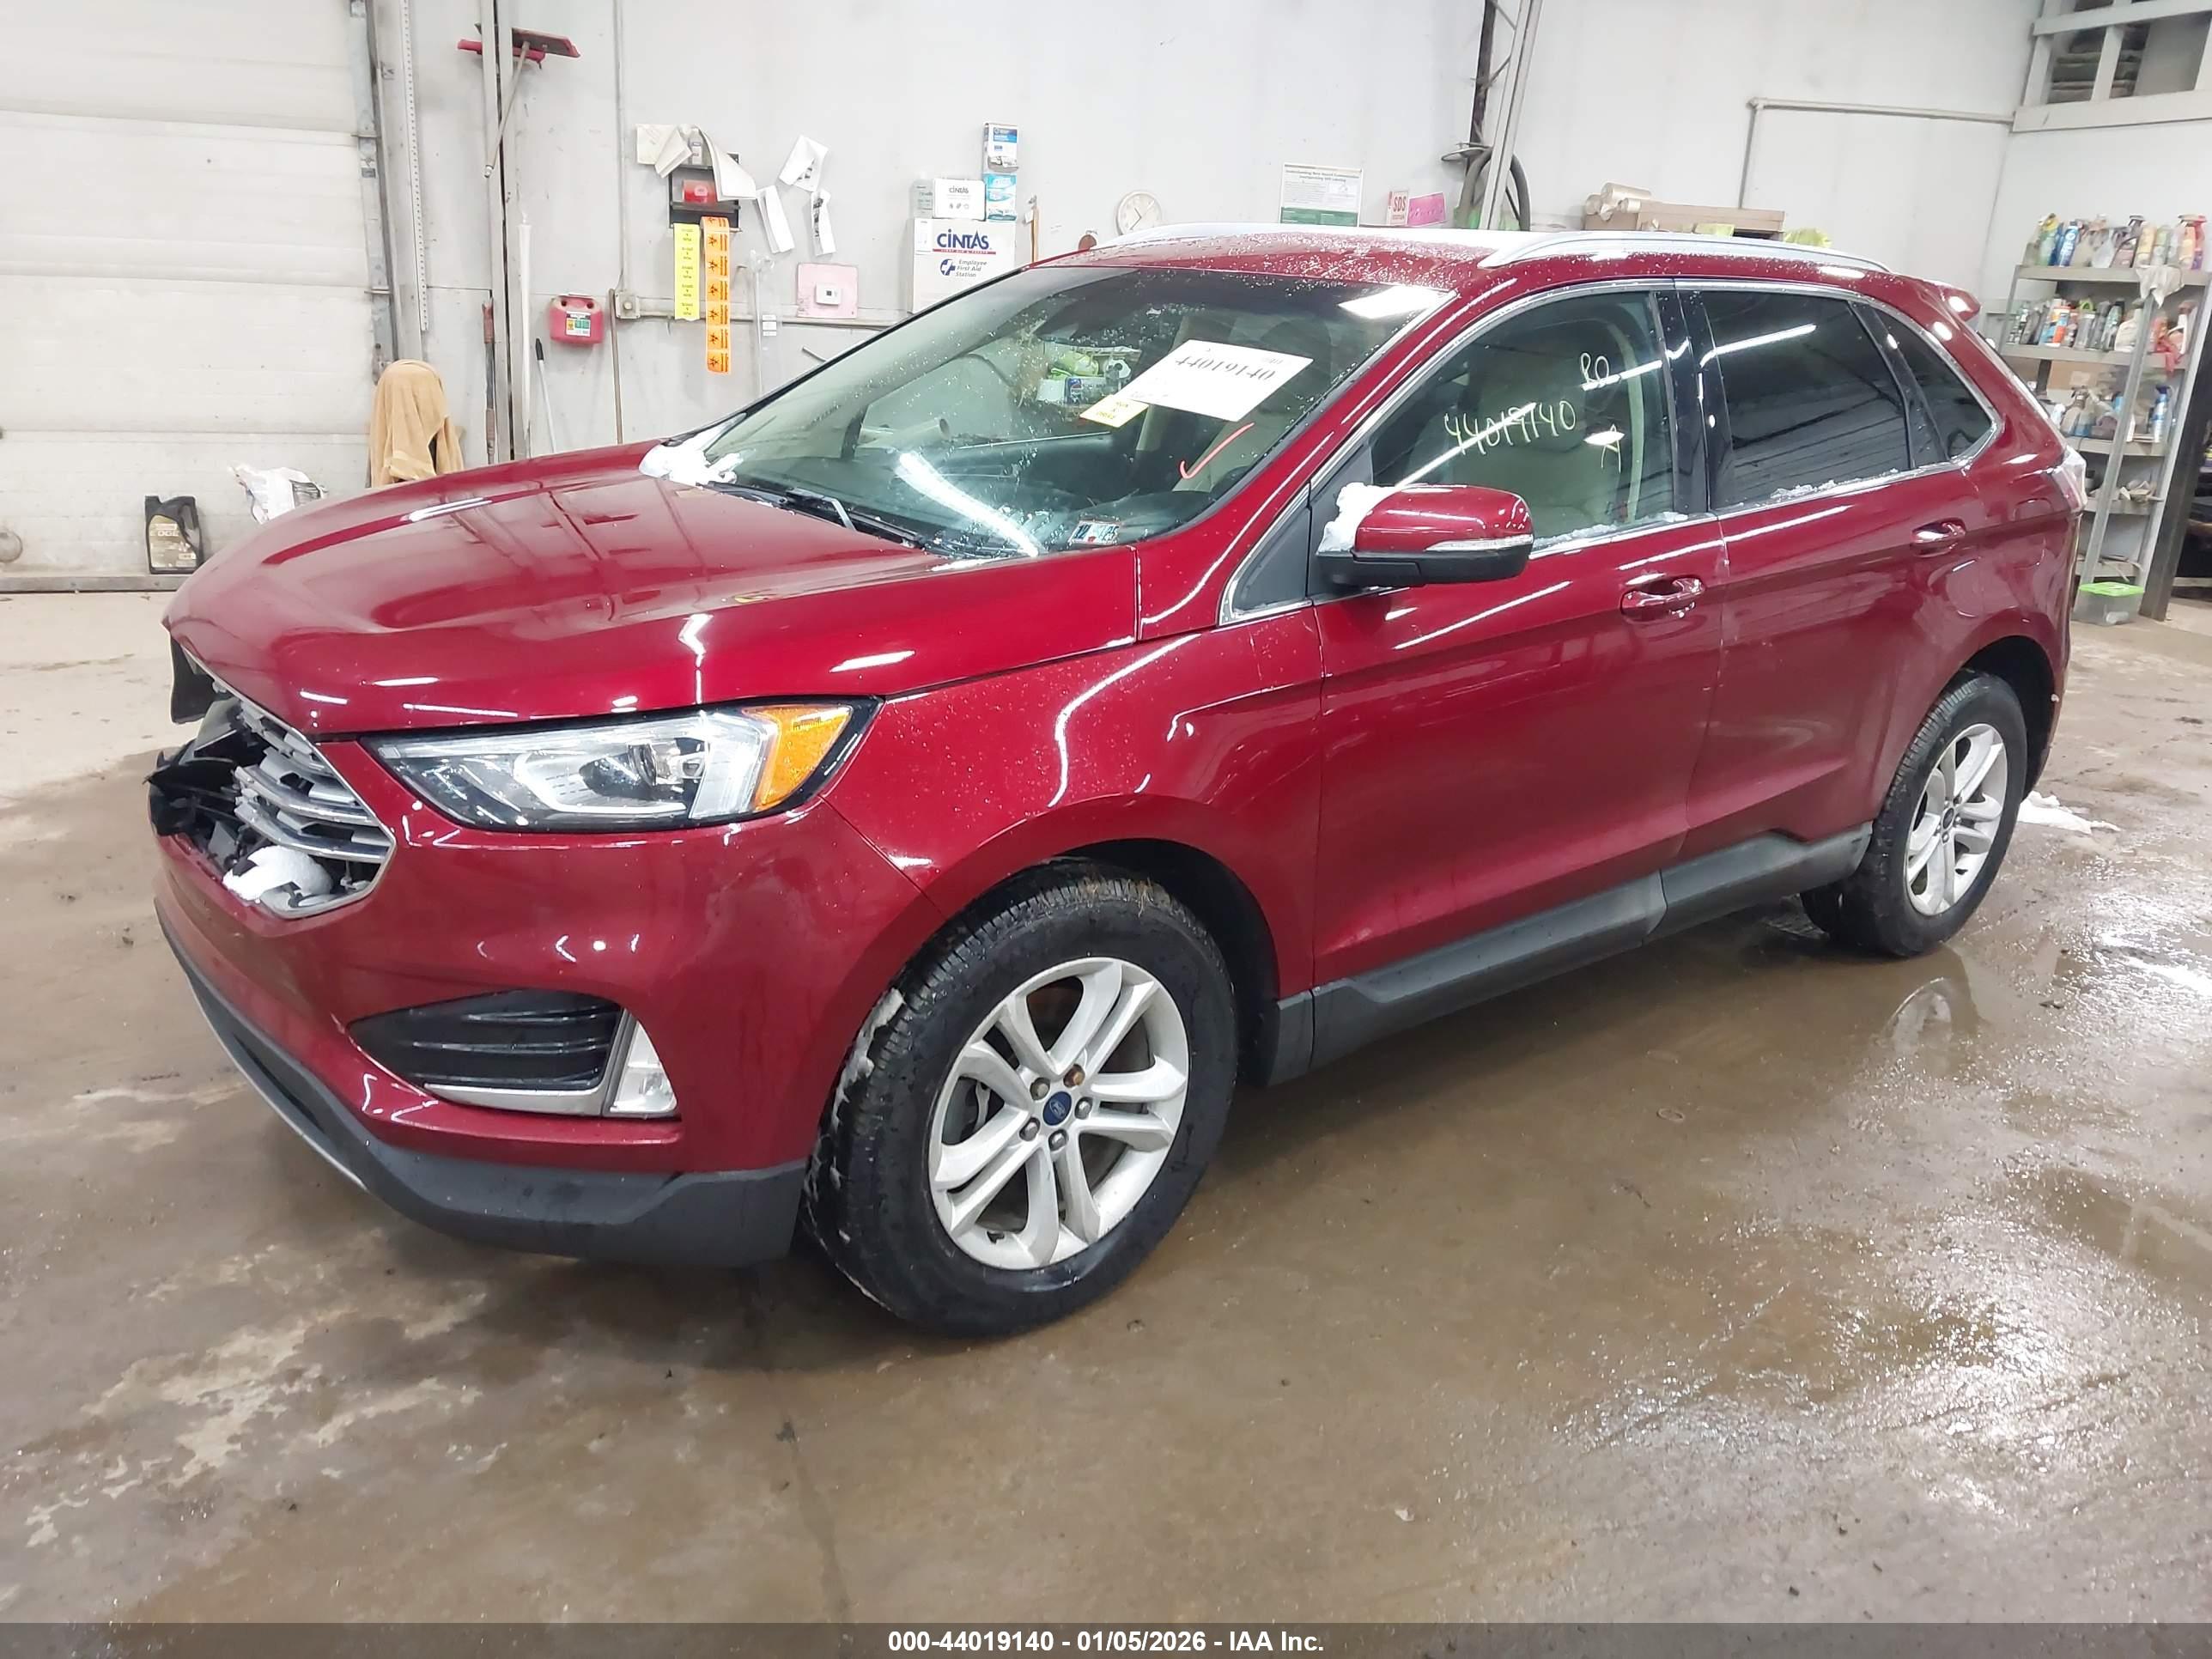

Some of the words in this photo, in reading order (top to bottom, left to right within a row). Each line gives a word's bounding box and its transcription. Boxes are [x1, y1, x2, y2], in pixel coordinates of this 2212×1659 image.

[1394, 196, 1407, 212] SDS
[1176, 356, 1276, 381] 44019140
[1444, 400, 1576, 456] 44019140
